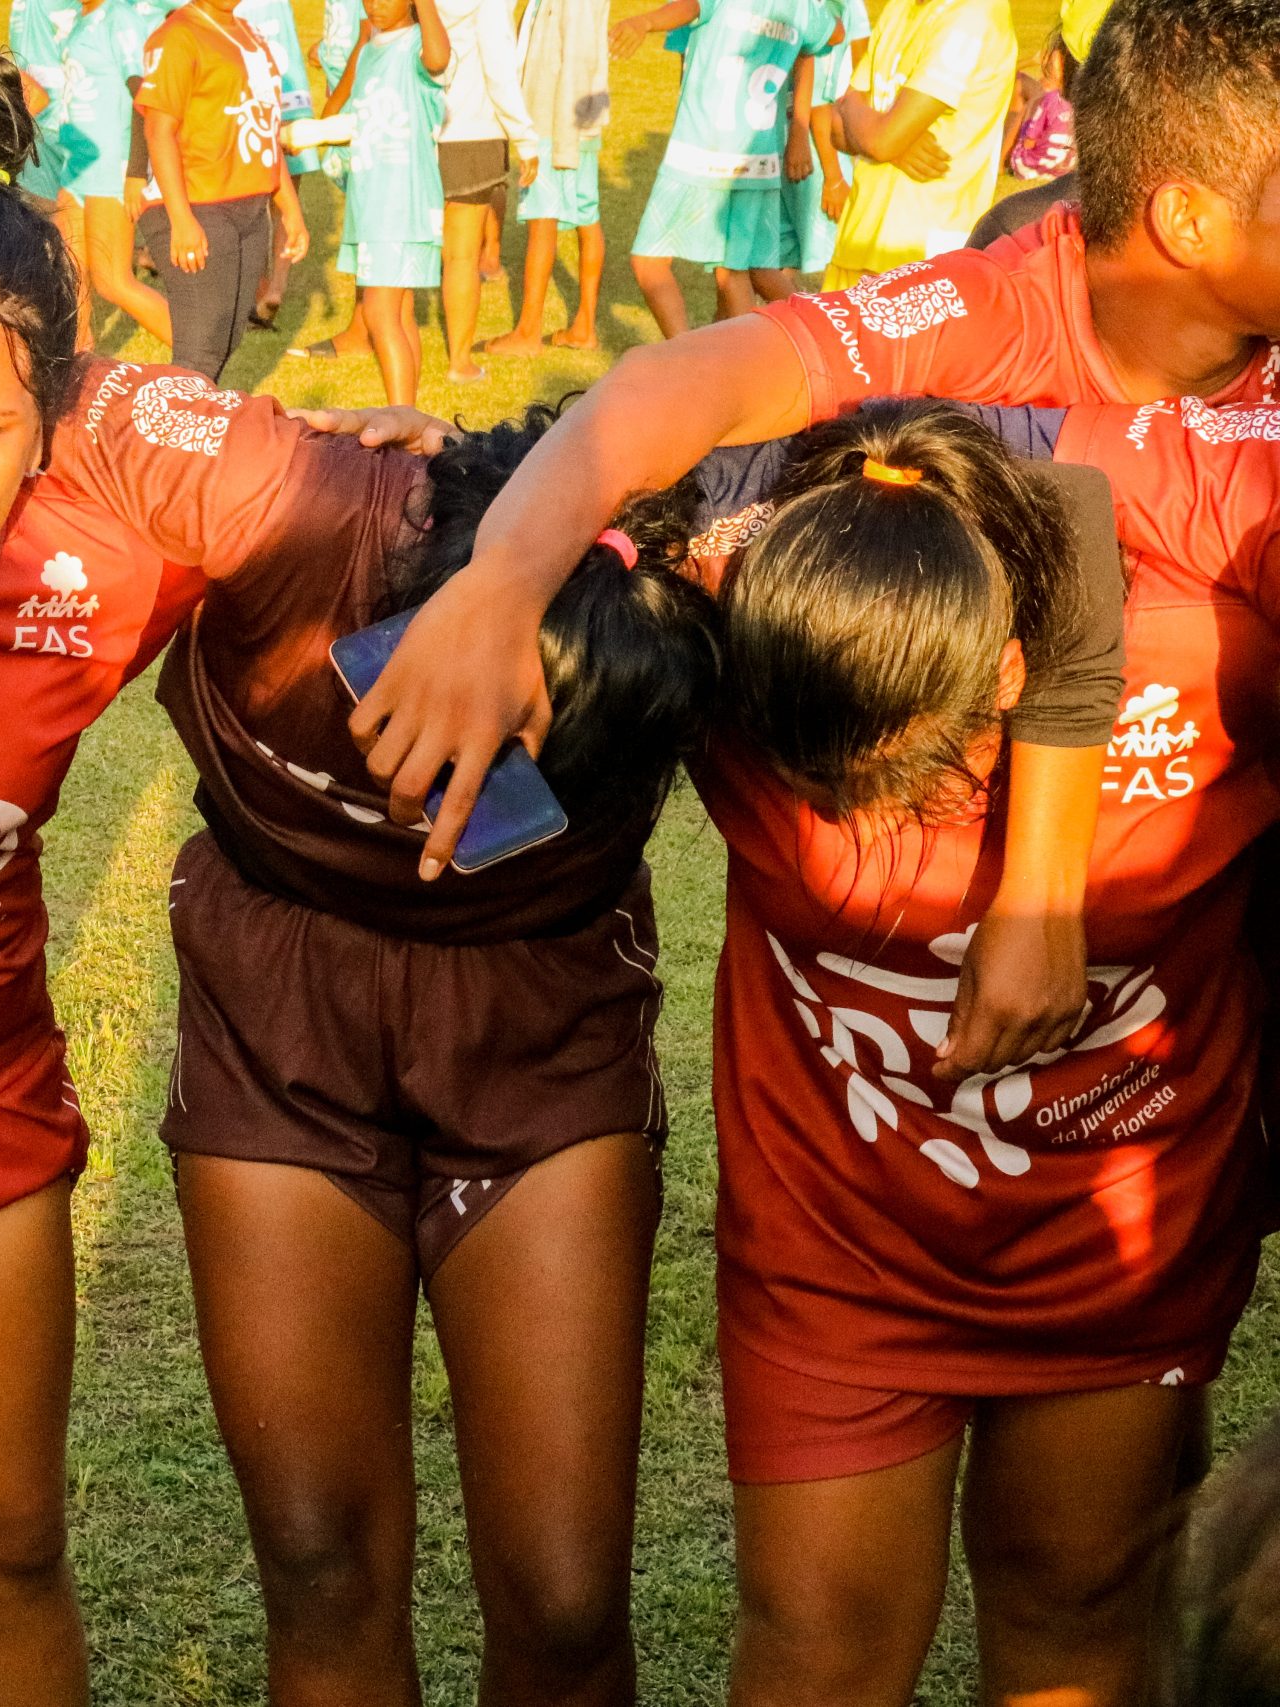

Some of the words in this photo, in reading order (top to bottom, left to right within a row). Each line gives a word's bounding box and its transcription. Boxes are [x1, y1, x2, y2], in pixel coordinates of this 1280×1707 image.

[9, 624, 94, 659] FAS
[1080, 1064, 1160, 1139] Juventude
[1112, 1085, 1177, 1142] Floresta
